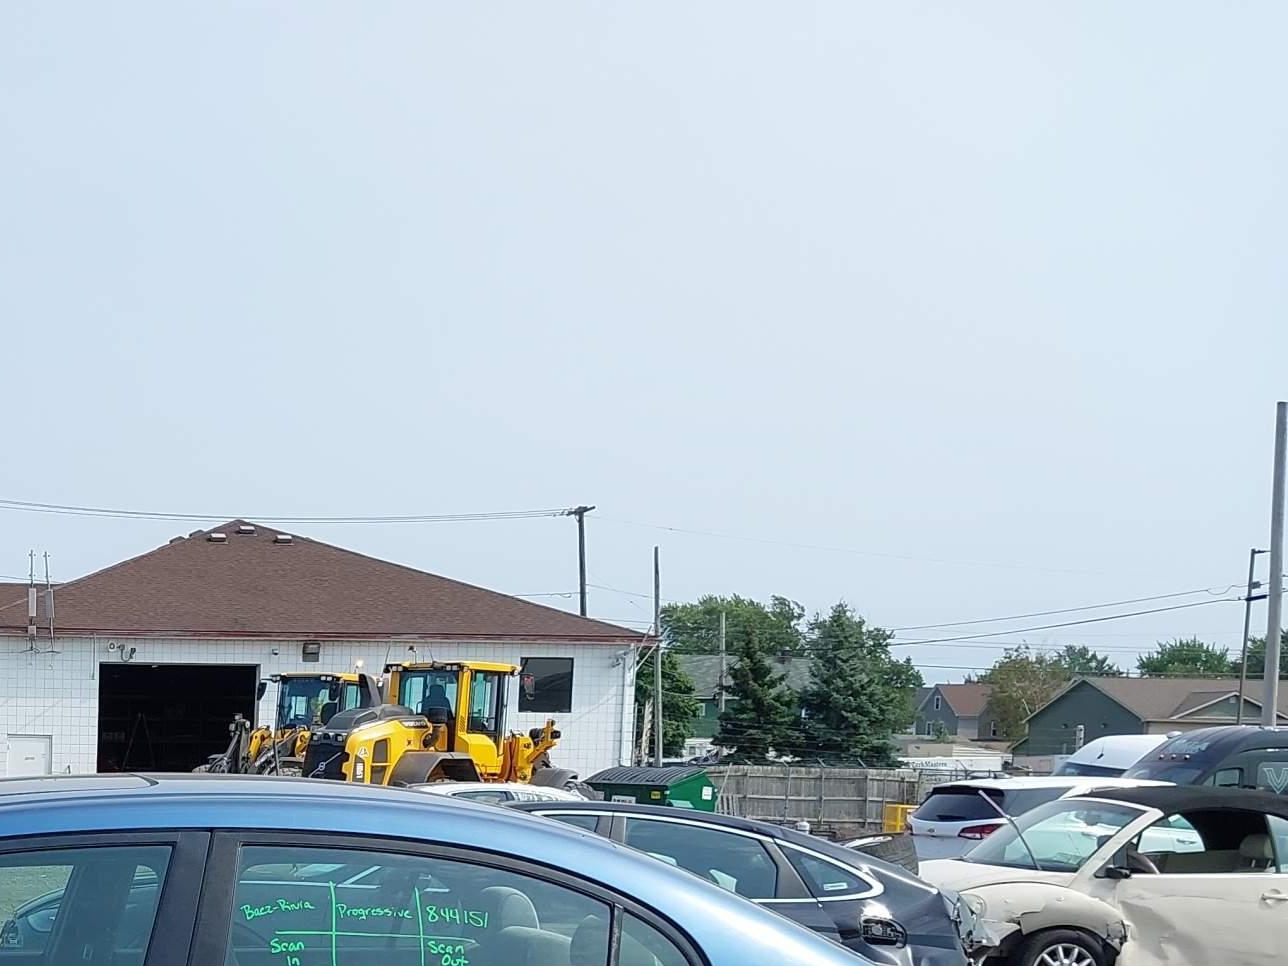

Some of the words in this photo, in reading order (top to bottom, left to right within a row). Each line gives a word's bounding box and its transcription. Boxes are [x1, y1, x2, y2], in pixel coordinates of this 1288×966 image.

[336, 904, 413, 920] Progressive
[270, 939, 305, 953] Scan
[427, 941, 464, 955] Scan
[287, 956, 300, 966] In
